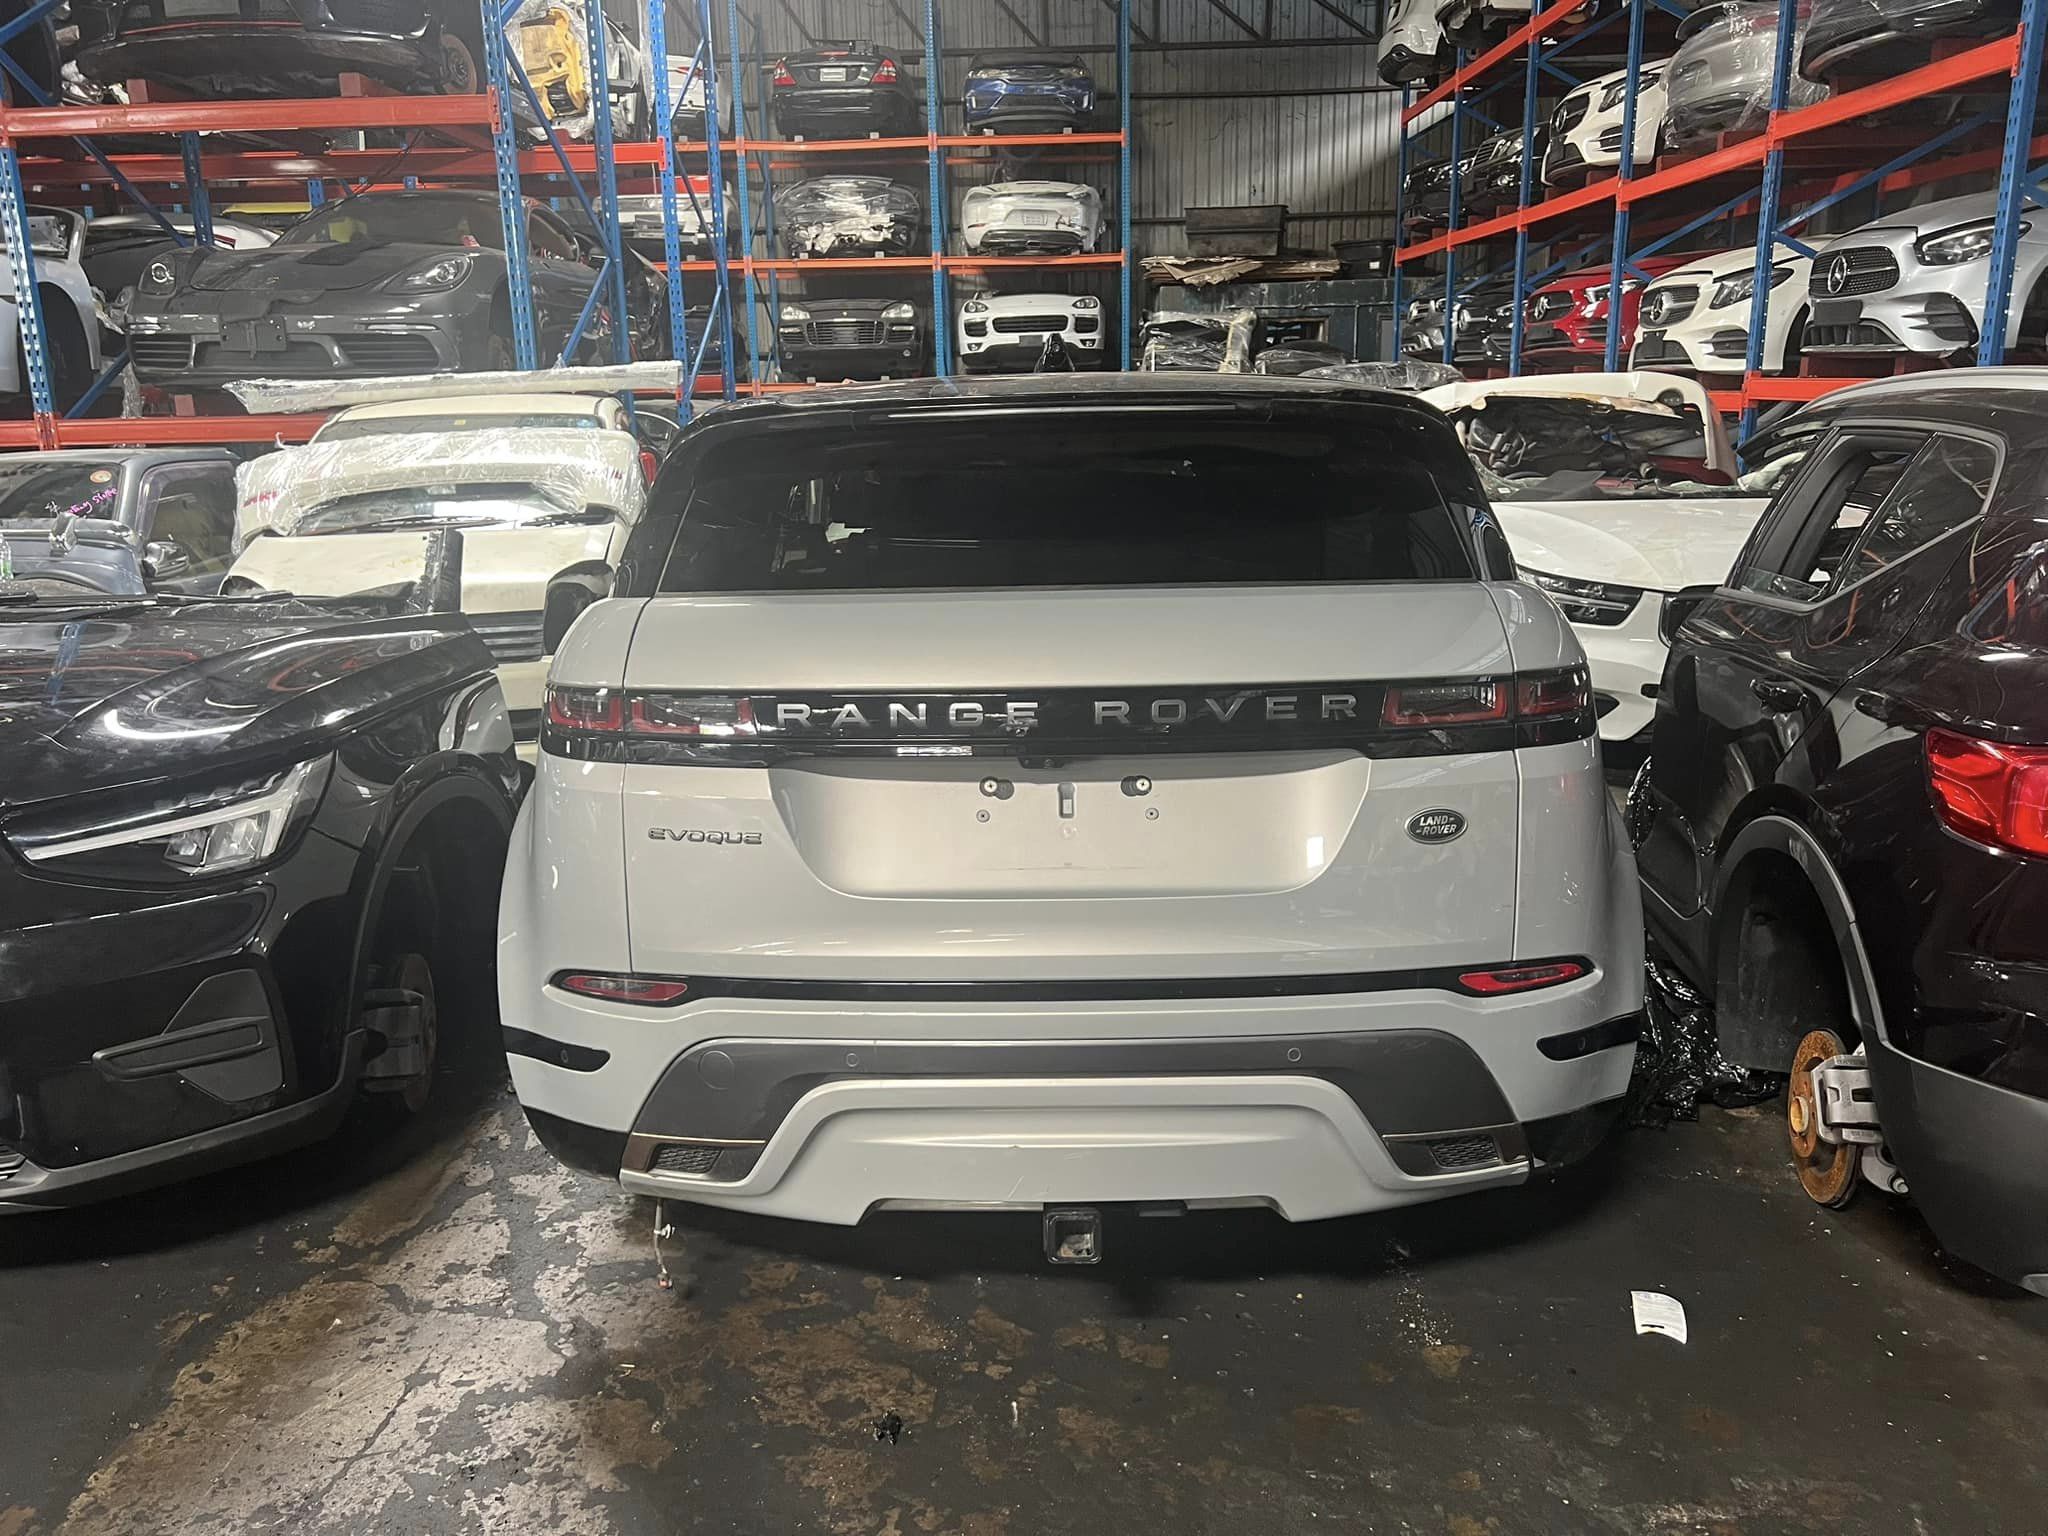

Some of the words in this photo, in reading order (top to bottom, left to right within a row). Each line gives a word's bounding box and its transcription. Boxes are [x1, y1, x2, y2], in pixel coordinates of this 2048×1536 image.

[776, 702, 1039, 729] RANGE
[1093, 693, 1357, 725] ROVER
[648, 827, 762, 845] EVOQUE
